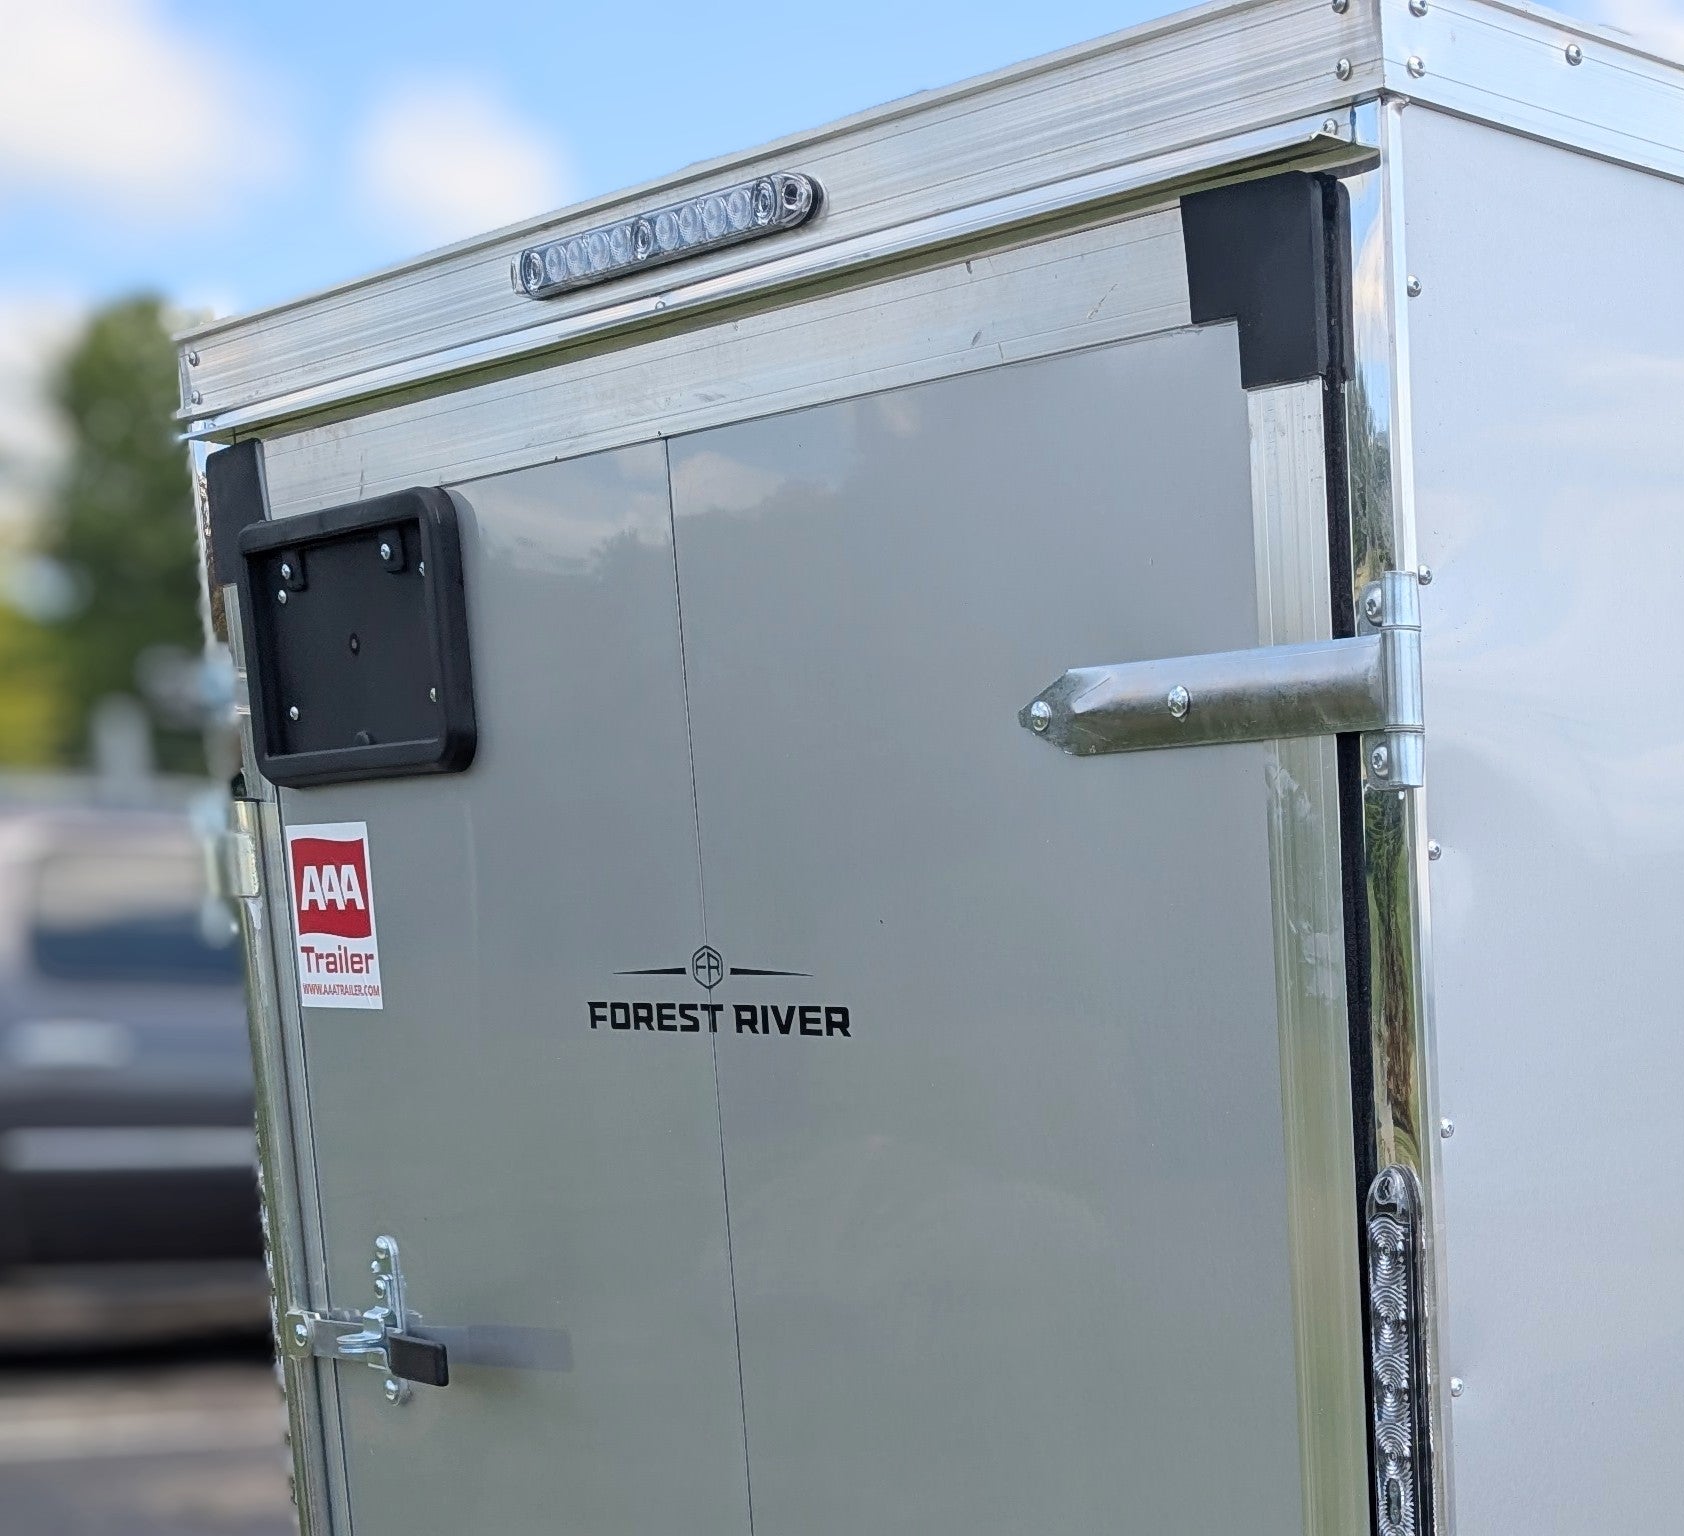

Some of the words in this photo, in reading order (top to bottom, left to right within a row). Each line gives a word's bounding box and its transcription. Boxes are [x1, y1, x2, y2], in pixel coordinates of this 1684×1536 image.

[301, 864, 366, 911] AAA
[300, 945, 375, 975] Trailer
[302, 983, 381, 997] WWW.AAATRAILER.COM
[586, 1001, 724, 1033] FOREST
[732, 1004, 852, 1038] RIVER
